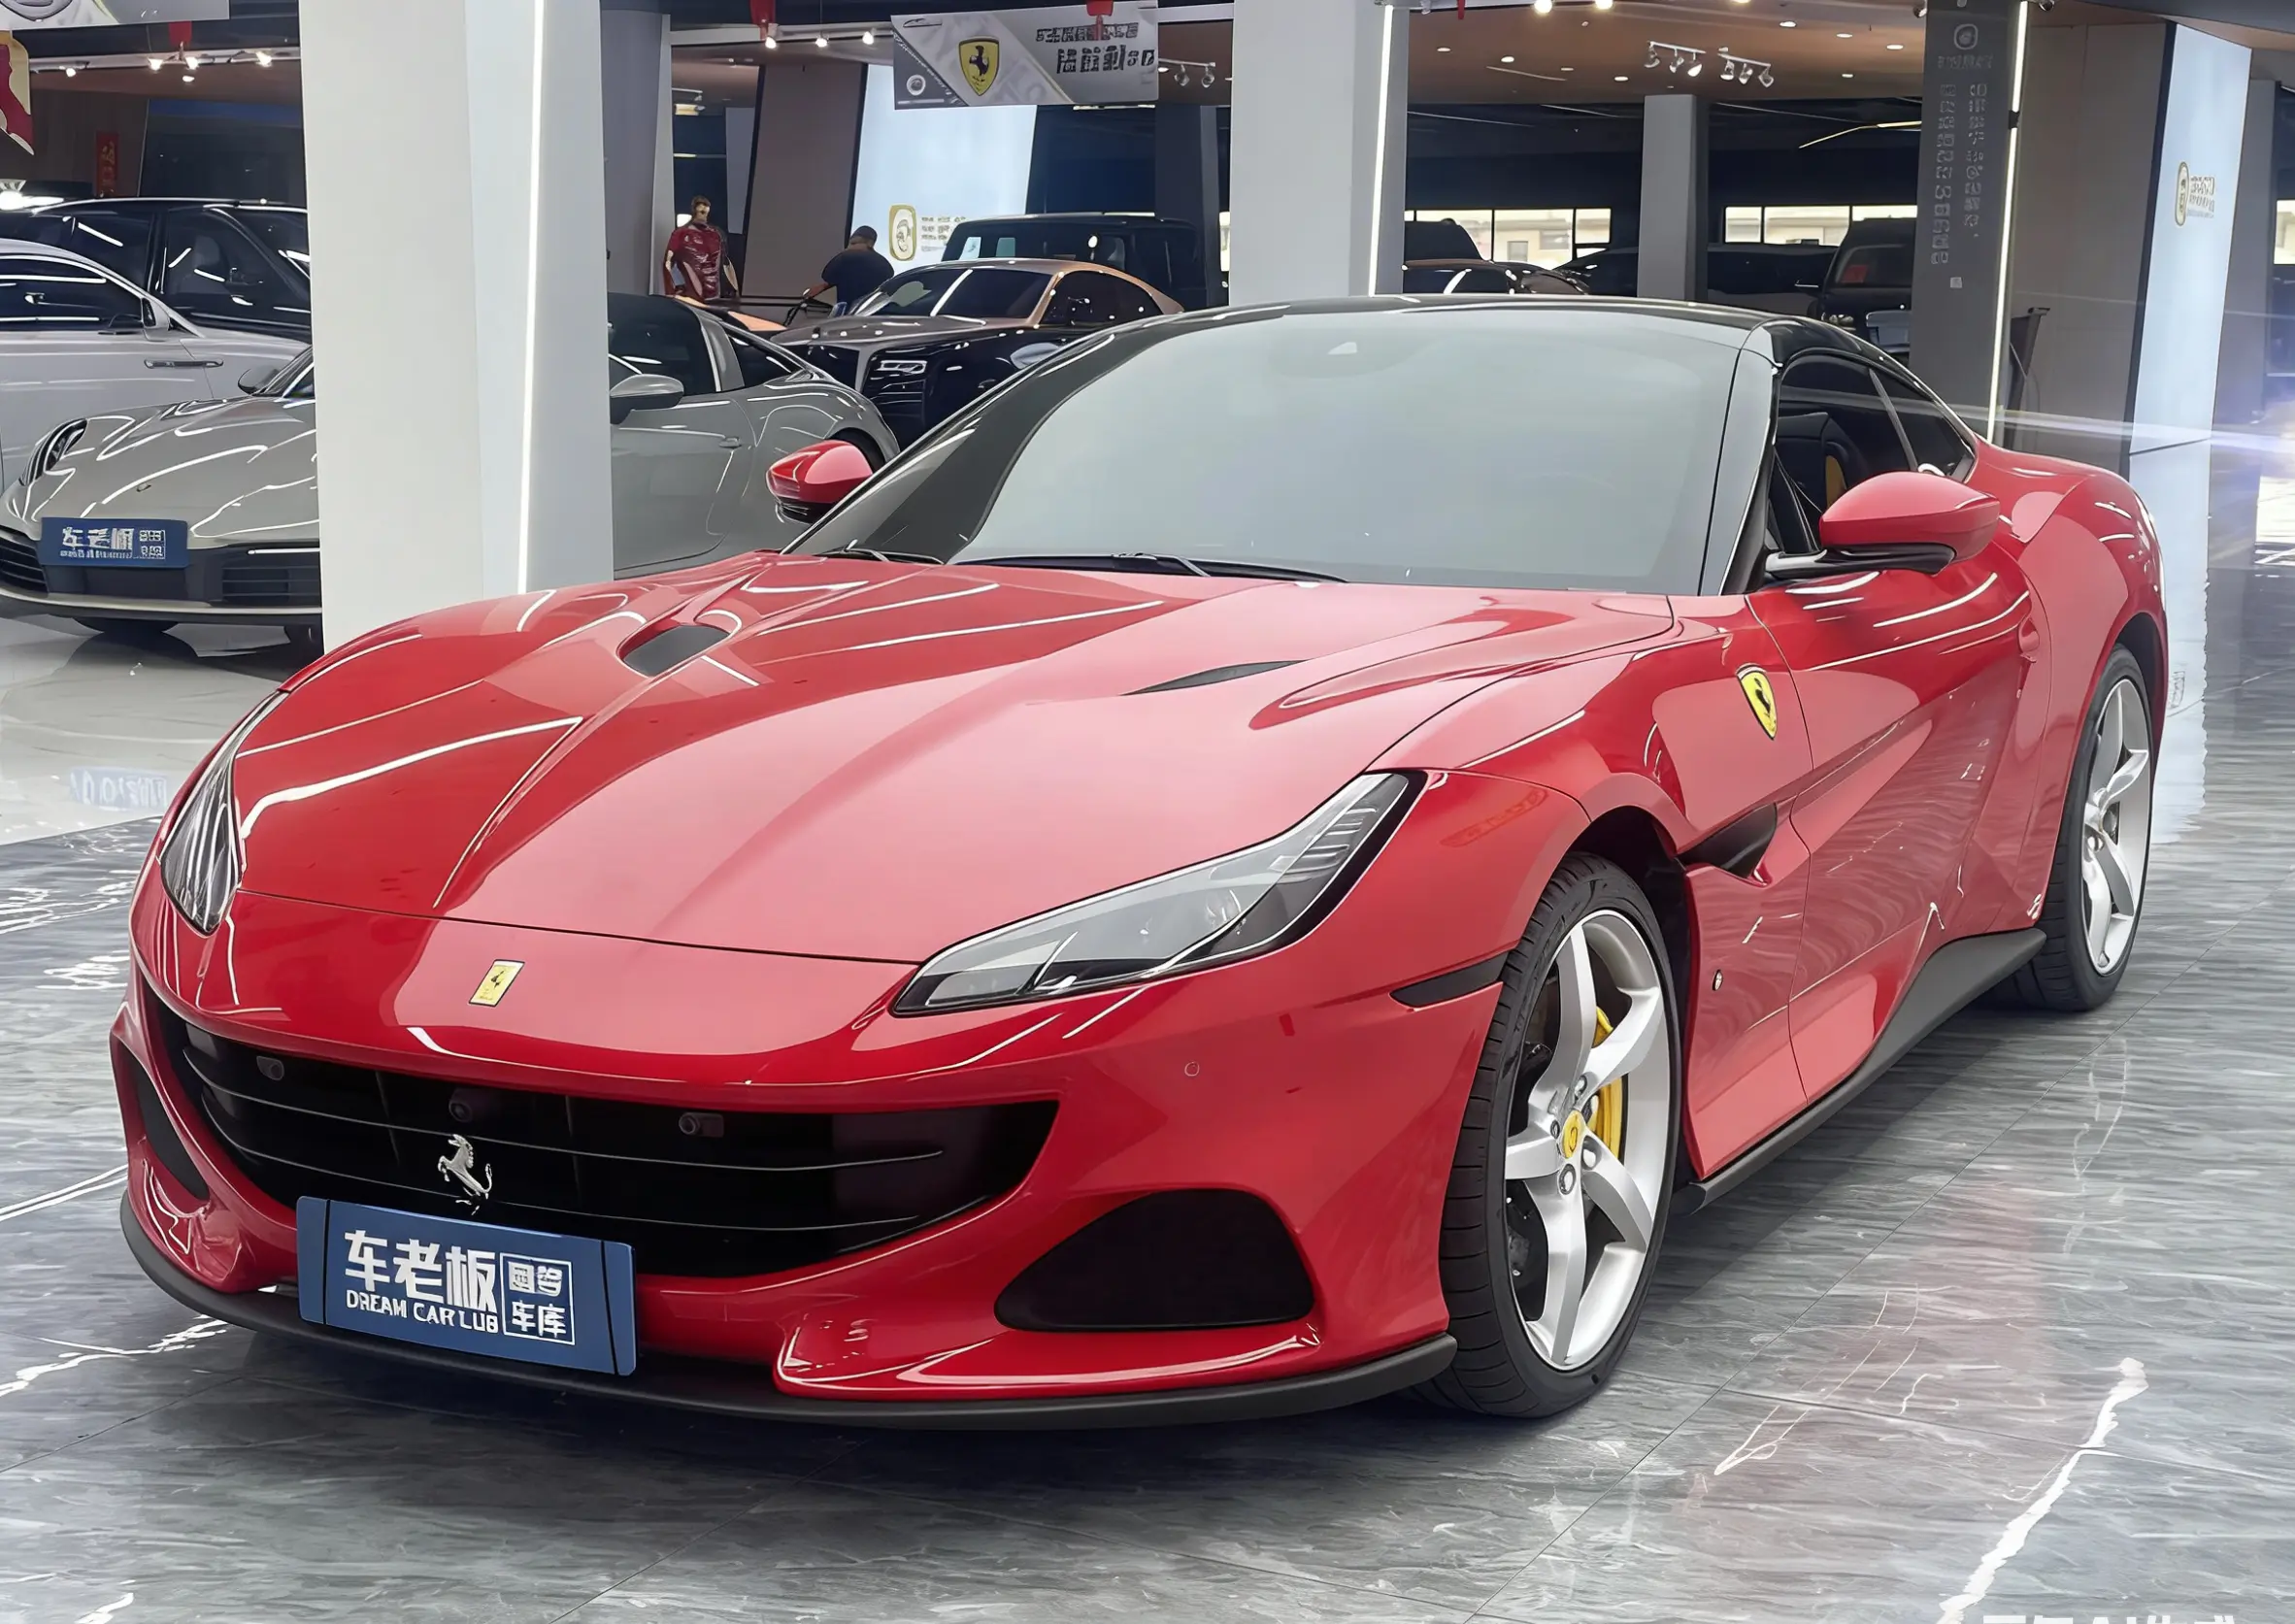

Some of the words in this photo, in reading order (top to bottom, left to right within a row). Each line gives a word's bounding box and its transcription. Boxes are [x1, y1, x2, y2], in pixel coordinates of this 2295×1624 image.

[344, 1230, 498, 1312] 车老板
[346, 1289, 408, 1318] DREAM
